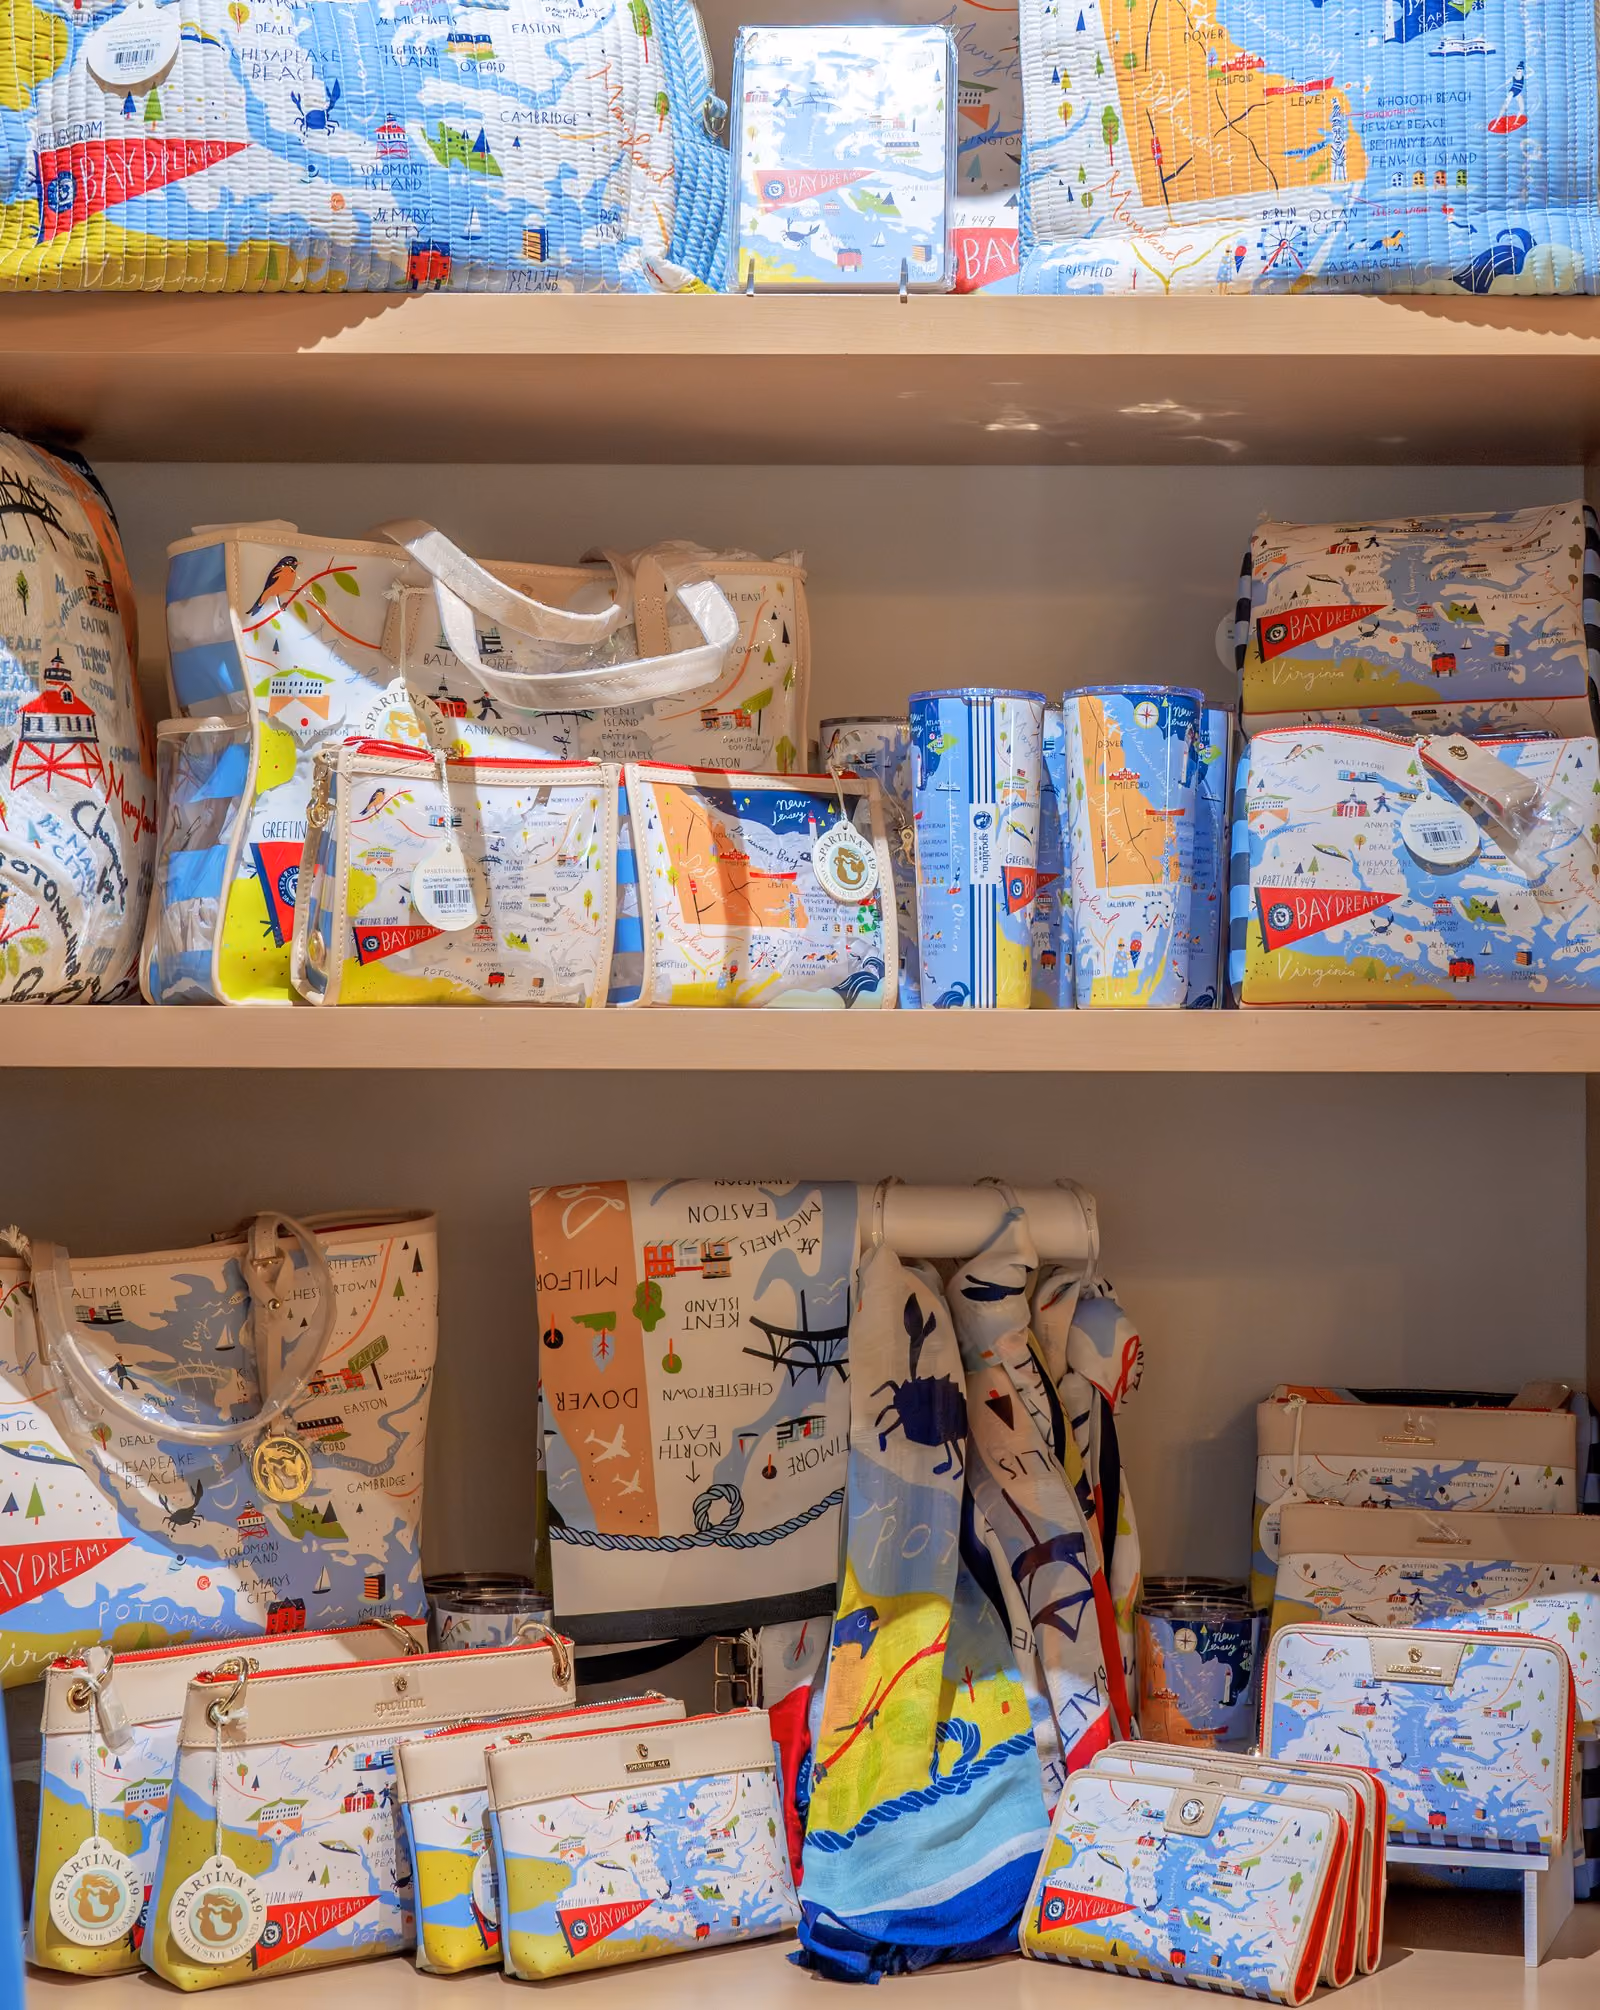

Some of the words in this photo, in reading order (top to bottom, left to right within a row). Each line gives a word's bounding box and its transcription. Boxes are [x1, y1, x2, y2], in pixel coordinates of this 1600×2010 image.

[464, 723, 538, 736] ANNAPOLIS
[700, 757, 741, 768] EASTON
[819, 832, 865, 863] SPARTINA
[688, 1202, 769, 1224] EASTON
[739, 1200, 823, 1257] MICHAELS
[352, 1255, 377, 1269] EAST
[71, 1283, 147, 1299] ALTIMORE
[684, 1296, 740, 1311] ISLAND
[682, 1311, 740, 1331] KENT
[555, 1387, 639, 1412] DOVER
[662, 1382, 774, 1401] CHESTERTOWN
[344, 1397, 388, 1415] EASTON
[119, 1435, 156, 1448] DEALE
[665, 1423, 717, 1442] EAST
[658, 1441, 722, 1461] NORTH
[105, 1452, 197, 1475] CHESAPEAKE
[125, 1471, 186, 1490] BEACH
[347, 1474, 407, 1494] CAMBRIDGE
[228, 1553, 278, 1570] ISLAND
[247, 1587, 281, 1604] CITY
[54, 1853, 123, 1902] SPARTINA
[124, 1867, 141, 1897] 449
[175, 1871, 246, 1920] SPARTINA
[246, 1885, 263, 1914] 449
[107, 1904, 138, 1940] ISLAND
